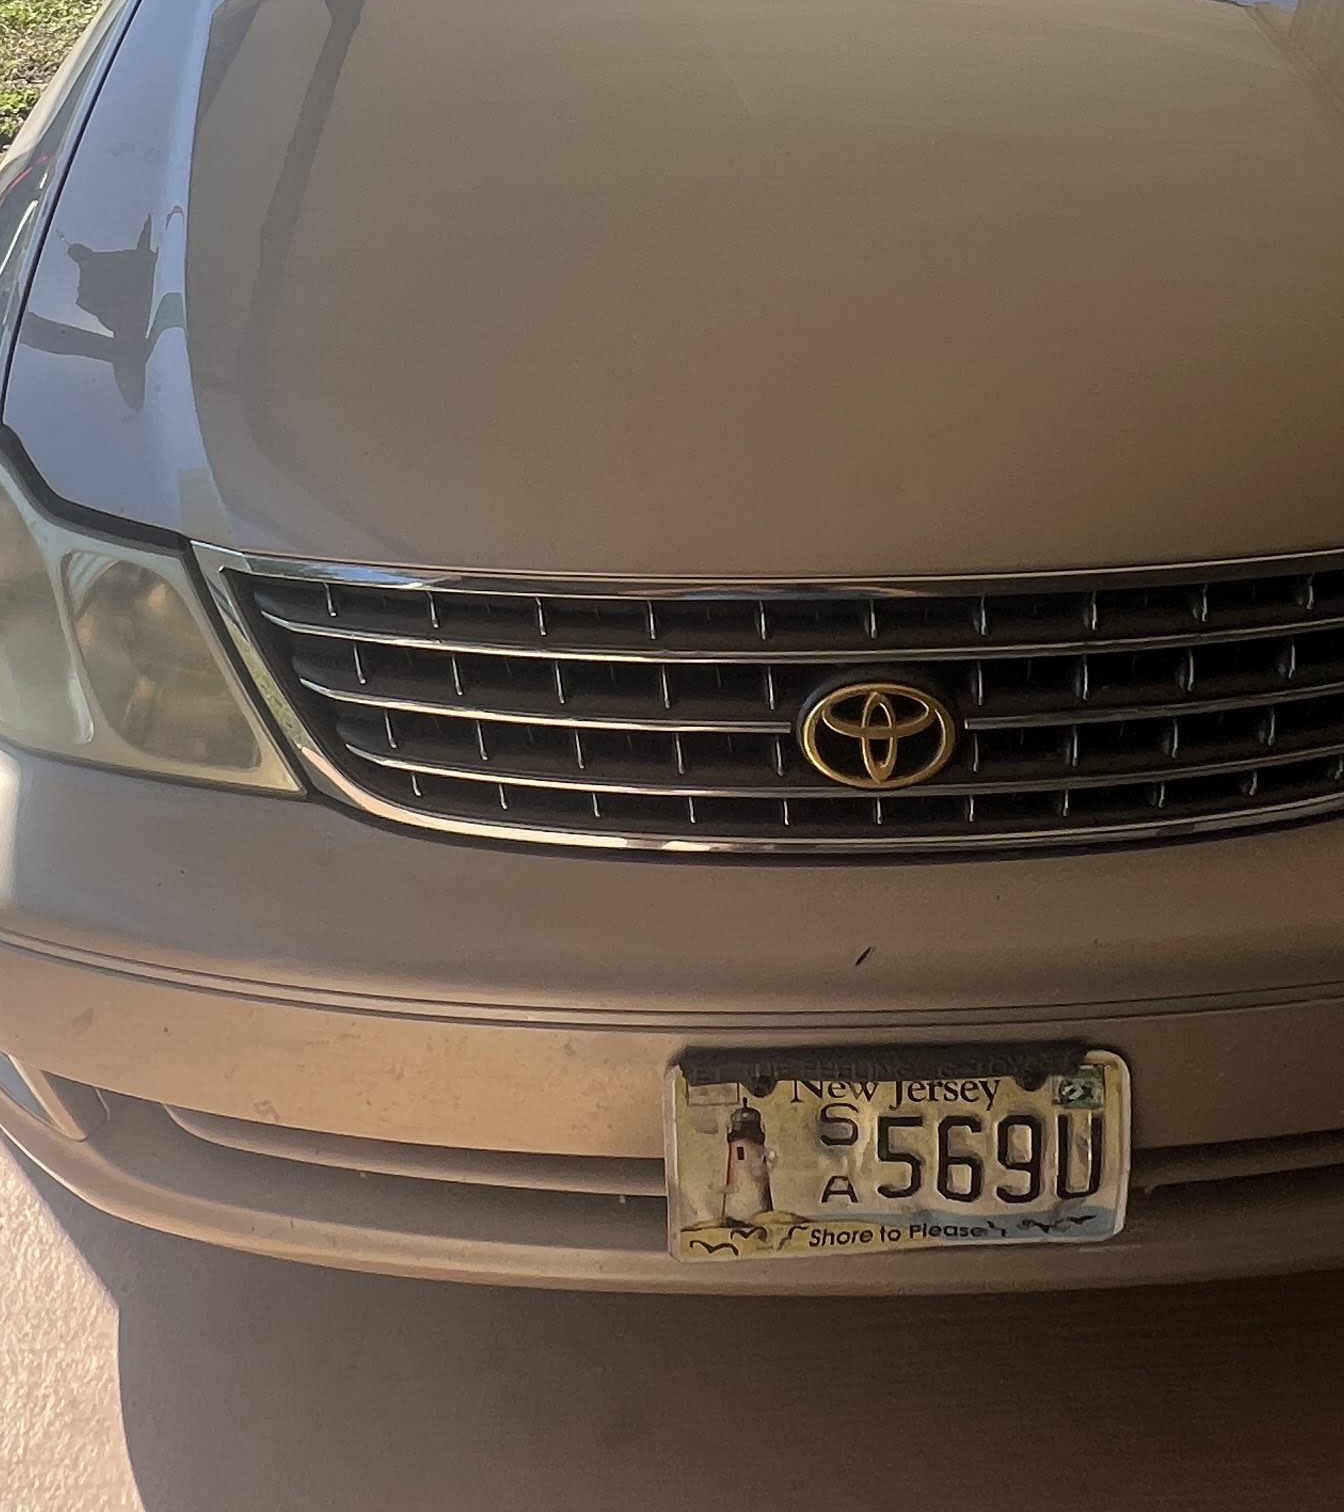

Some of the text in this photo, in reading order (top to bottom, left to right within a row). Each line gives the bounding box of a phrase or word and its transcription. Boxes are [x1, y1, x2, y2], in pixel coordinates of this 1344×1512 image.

[790, 1077, 1001, 1111] New Jersey
[809, 1222, 988, 1248] Shore to Please
